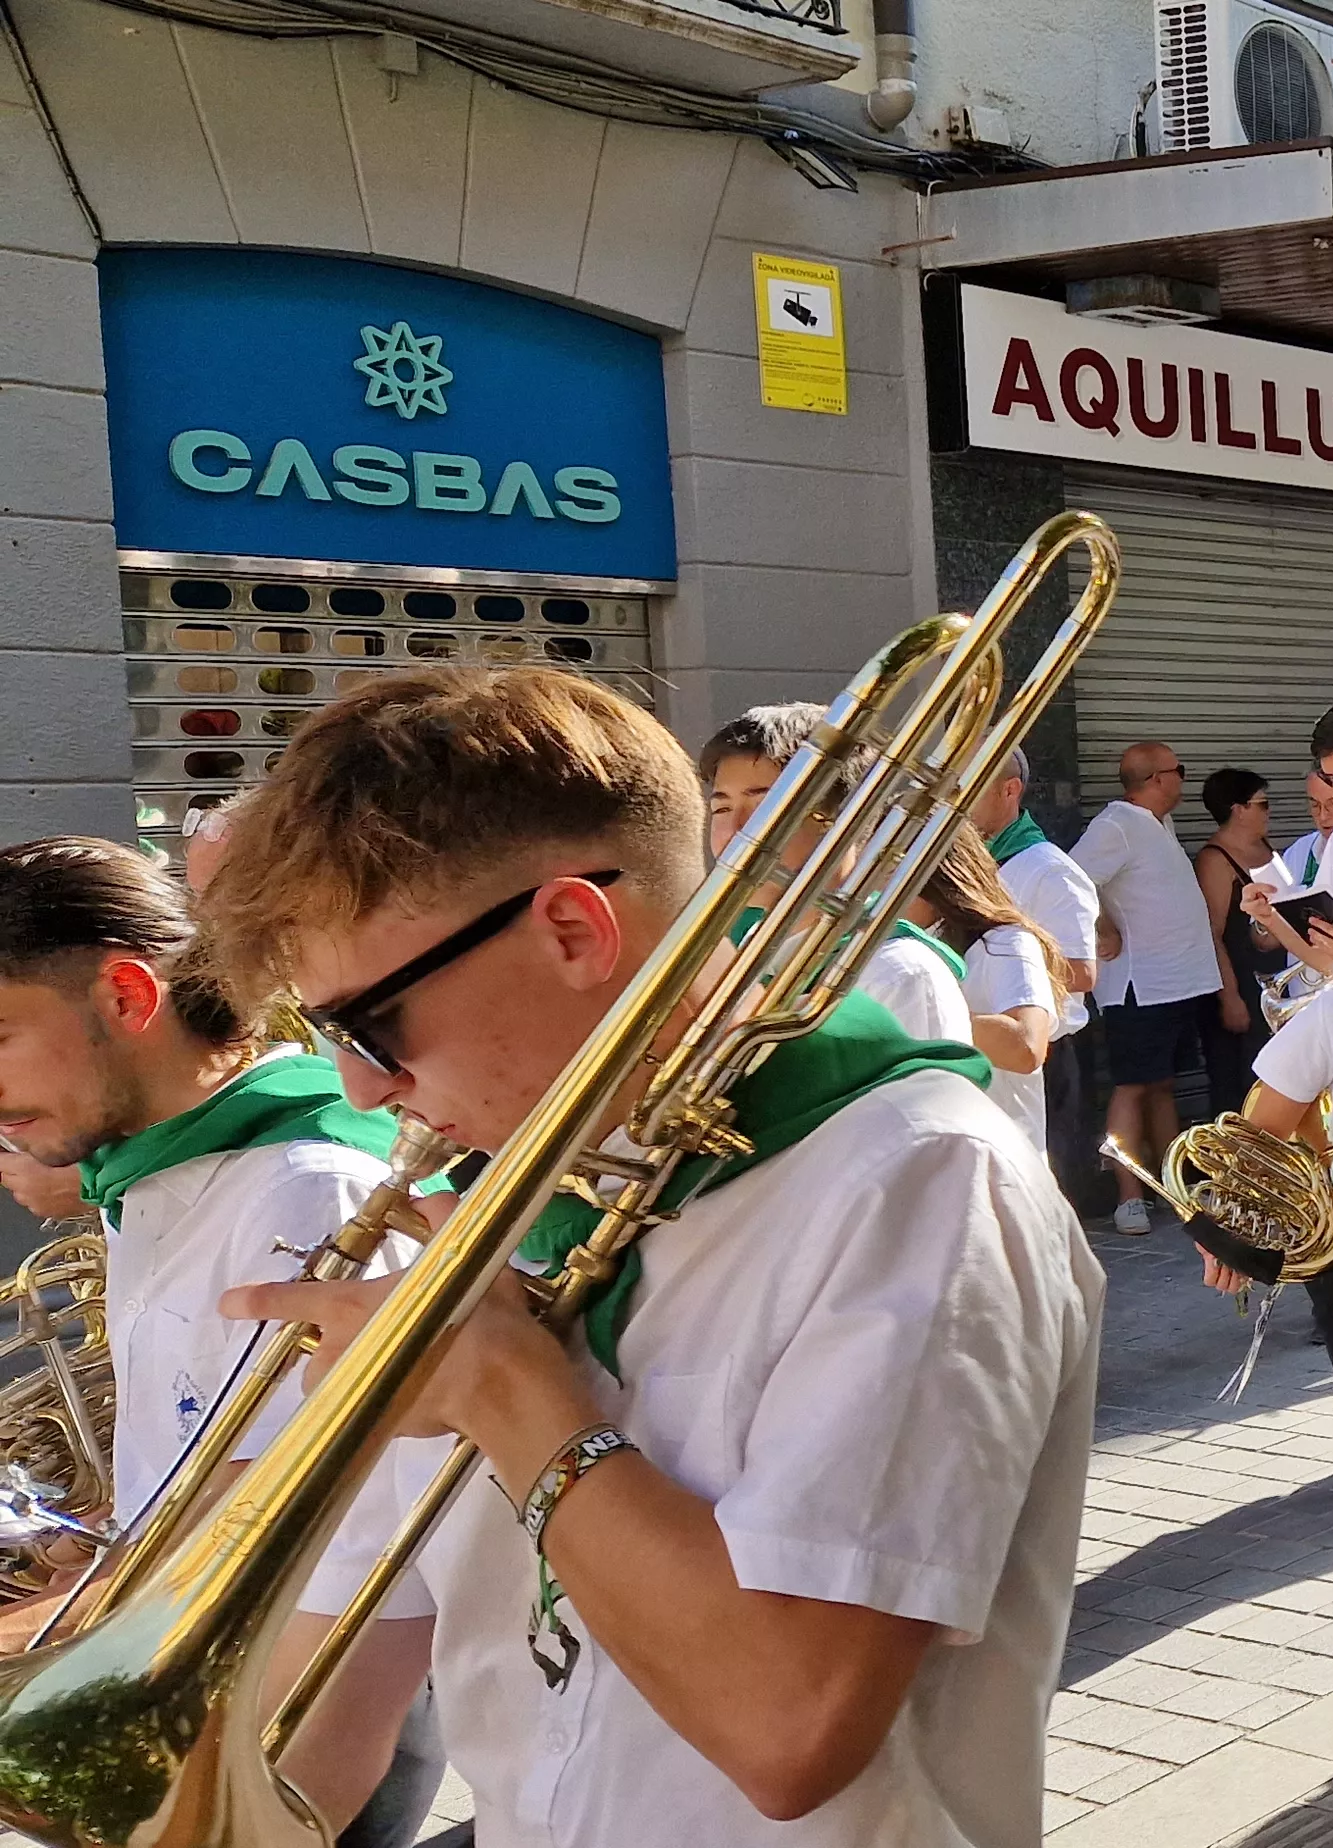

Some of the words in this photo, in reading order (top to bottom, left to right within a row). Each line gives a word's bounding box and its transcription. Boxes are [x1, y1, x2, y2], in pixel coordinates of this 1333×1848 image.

[758, 263, 779, 273] ZONA
[780, 266, 836, 281] VIDEOVIGILADA
[169, 428, 623, 524] CASBAS
